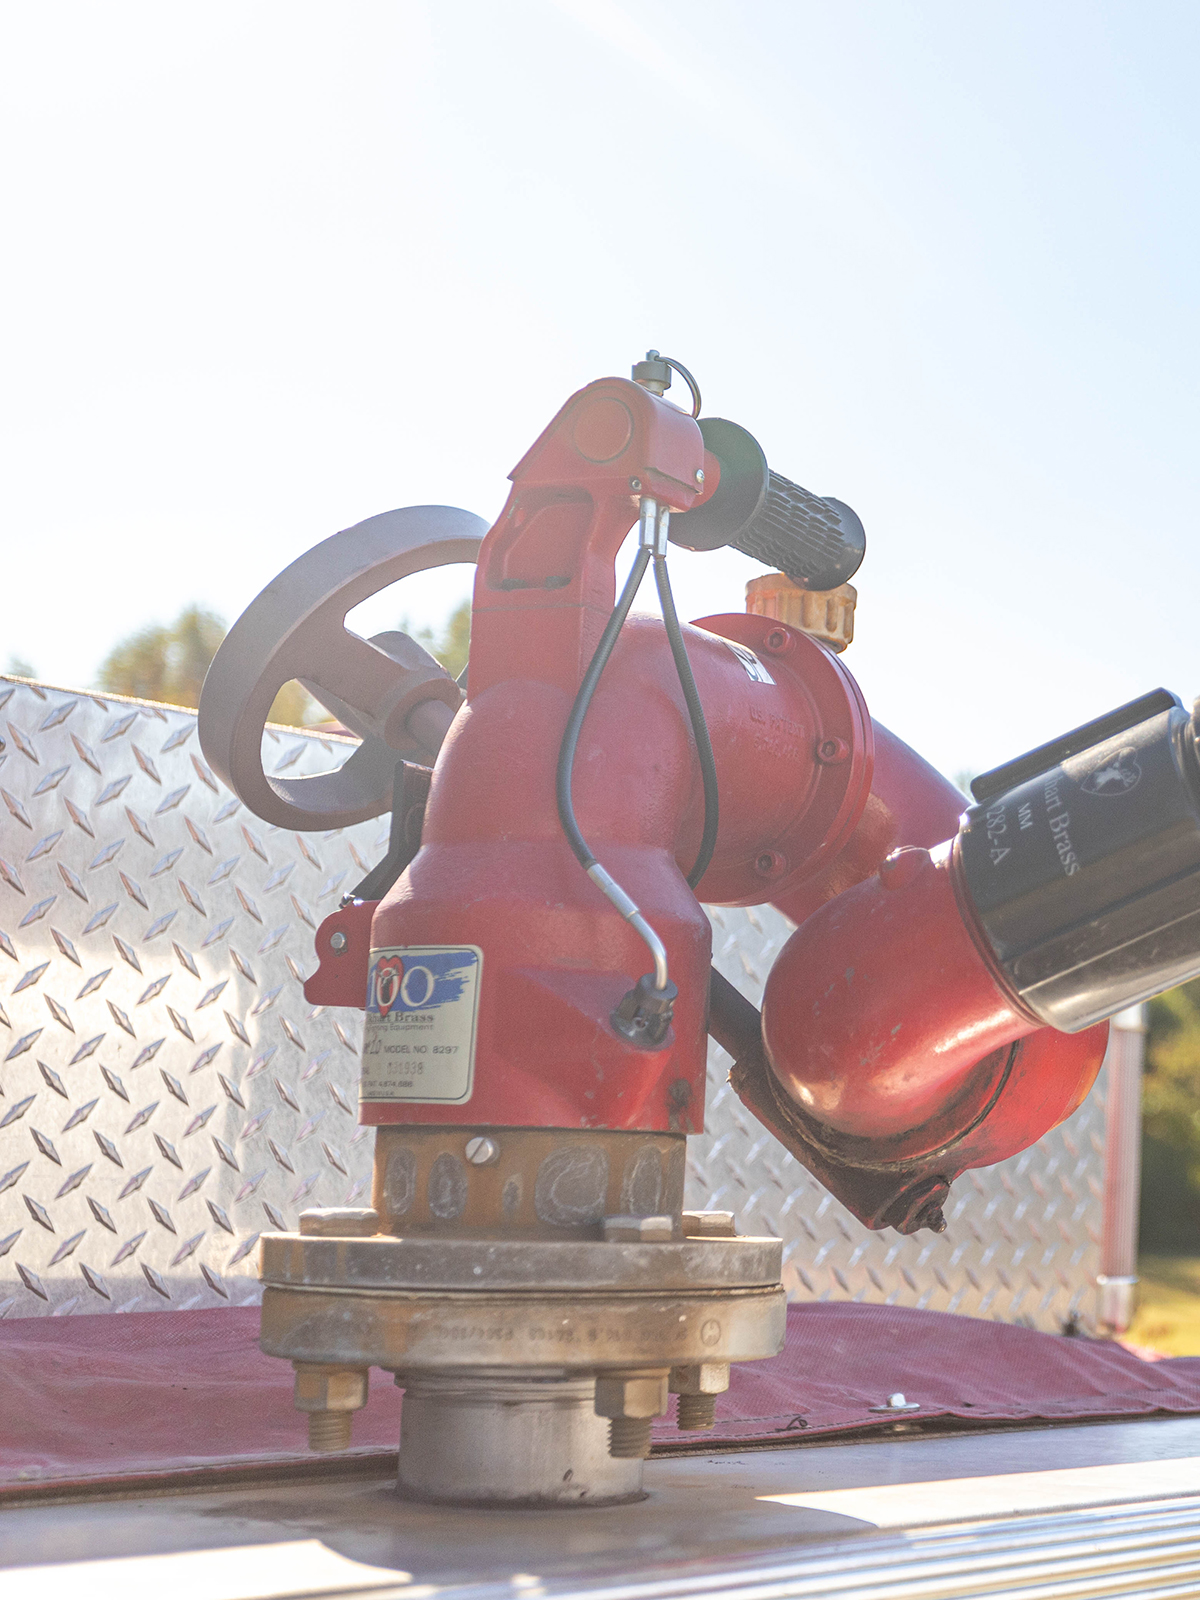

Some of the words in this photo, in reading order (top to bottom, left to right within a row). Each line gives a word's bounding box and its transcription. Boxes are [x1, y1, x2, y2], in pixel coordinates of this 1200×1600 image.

[1049, 811, 1080, 876] Brass
[395, 1011, 434, 1022] Brass
[384, 1045, 410, 1054] MODEL
[432, 1046, 458, 1055] 8297
